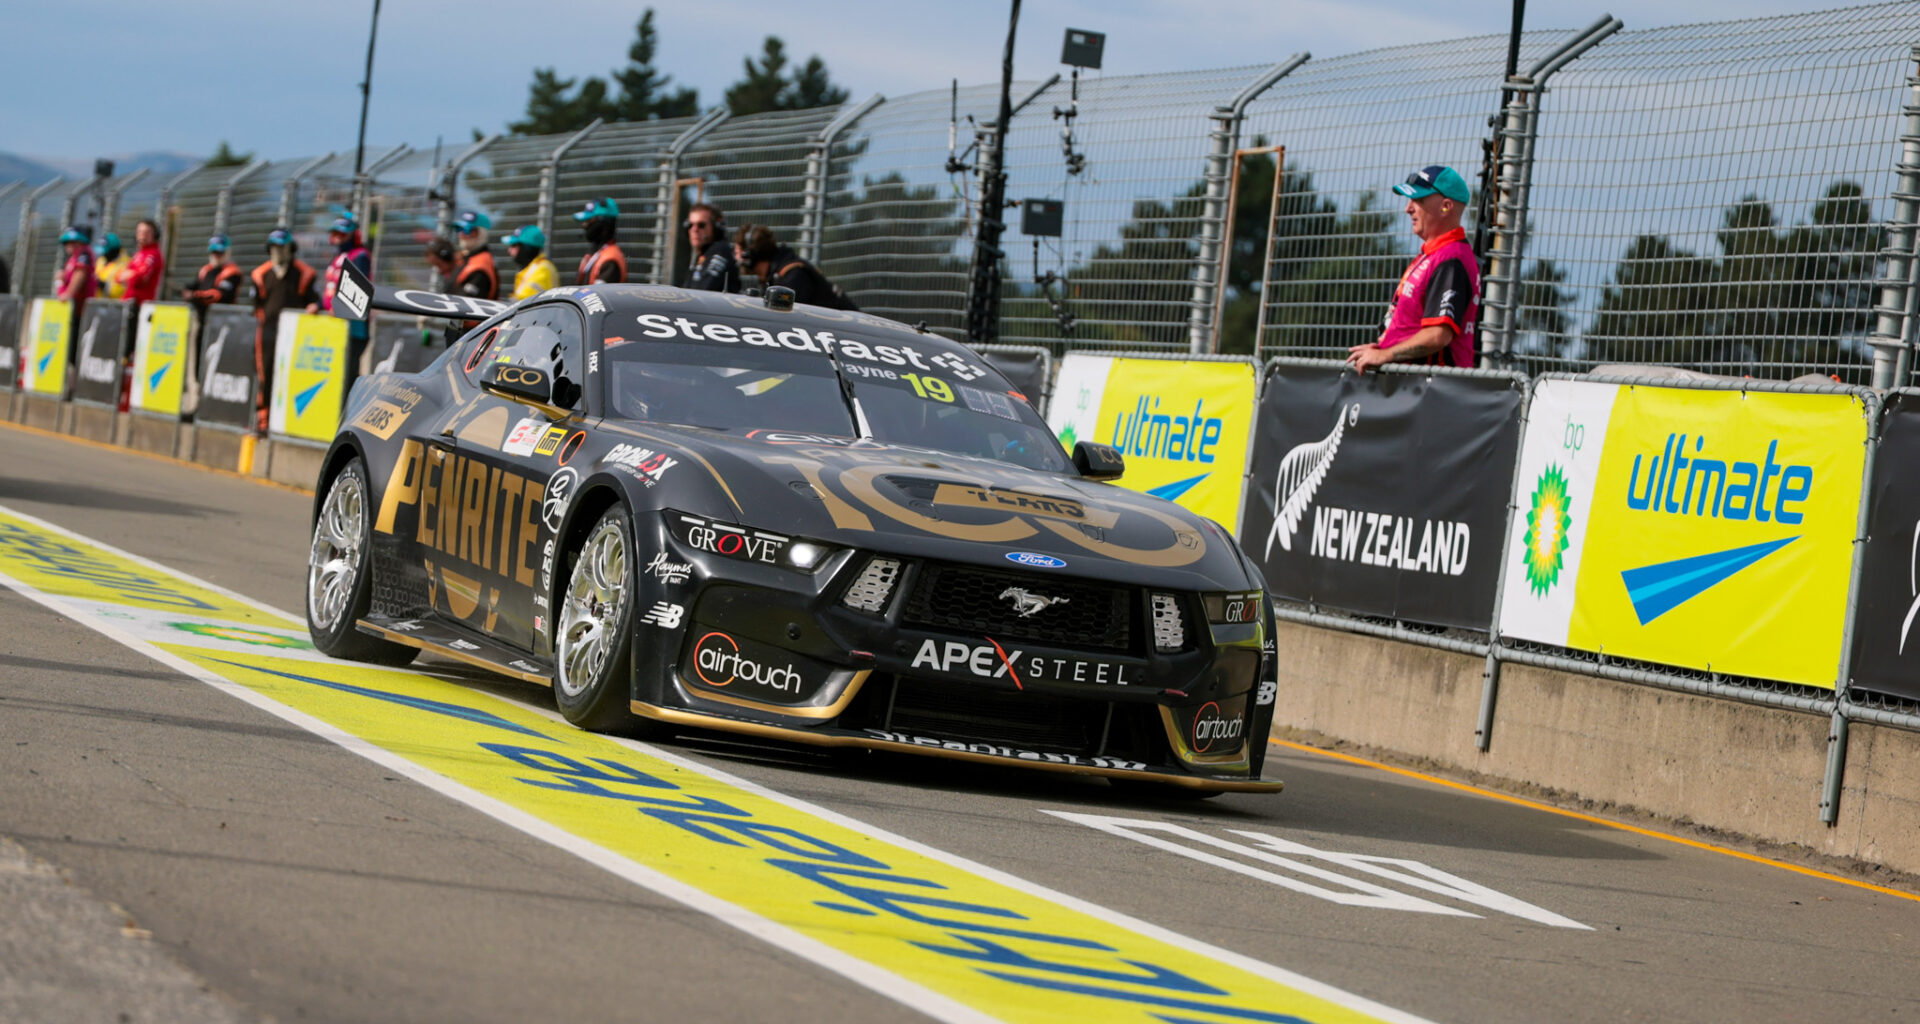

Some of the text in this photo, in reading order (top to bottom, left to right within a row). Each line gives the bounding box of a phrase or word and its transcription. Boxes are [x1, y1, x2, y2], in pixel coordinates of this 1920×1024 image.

[637, 313, 931, 372] Steadfast
[900, 372, 955, 403] 19
[1111, 394, 1223, 464] ultimate
[1563, 413, 1585, 460] bp
[1627, 432, 1814, 525] ultimate
[374, 438, 549, 588] PENRITE
[644, 552, 693, 584] Haymes
[1015, 553, 1058, 567] Ford
[699, 647, 801, 694] airtouch
[910, 637, 1128, 688] APEX STEEL
[1195, 711, 1243, 740] airtouch
